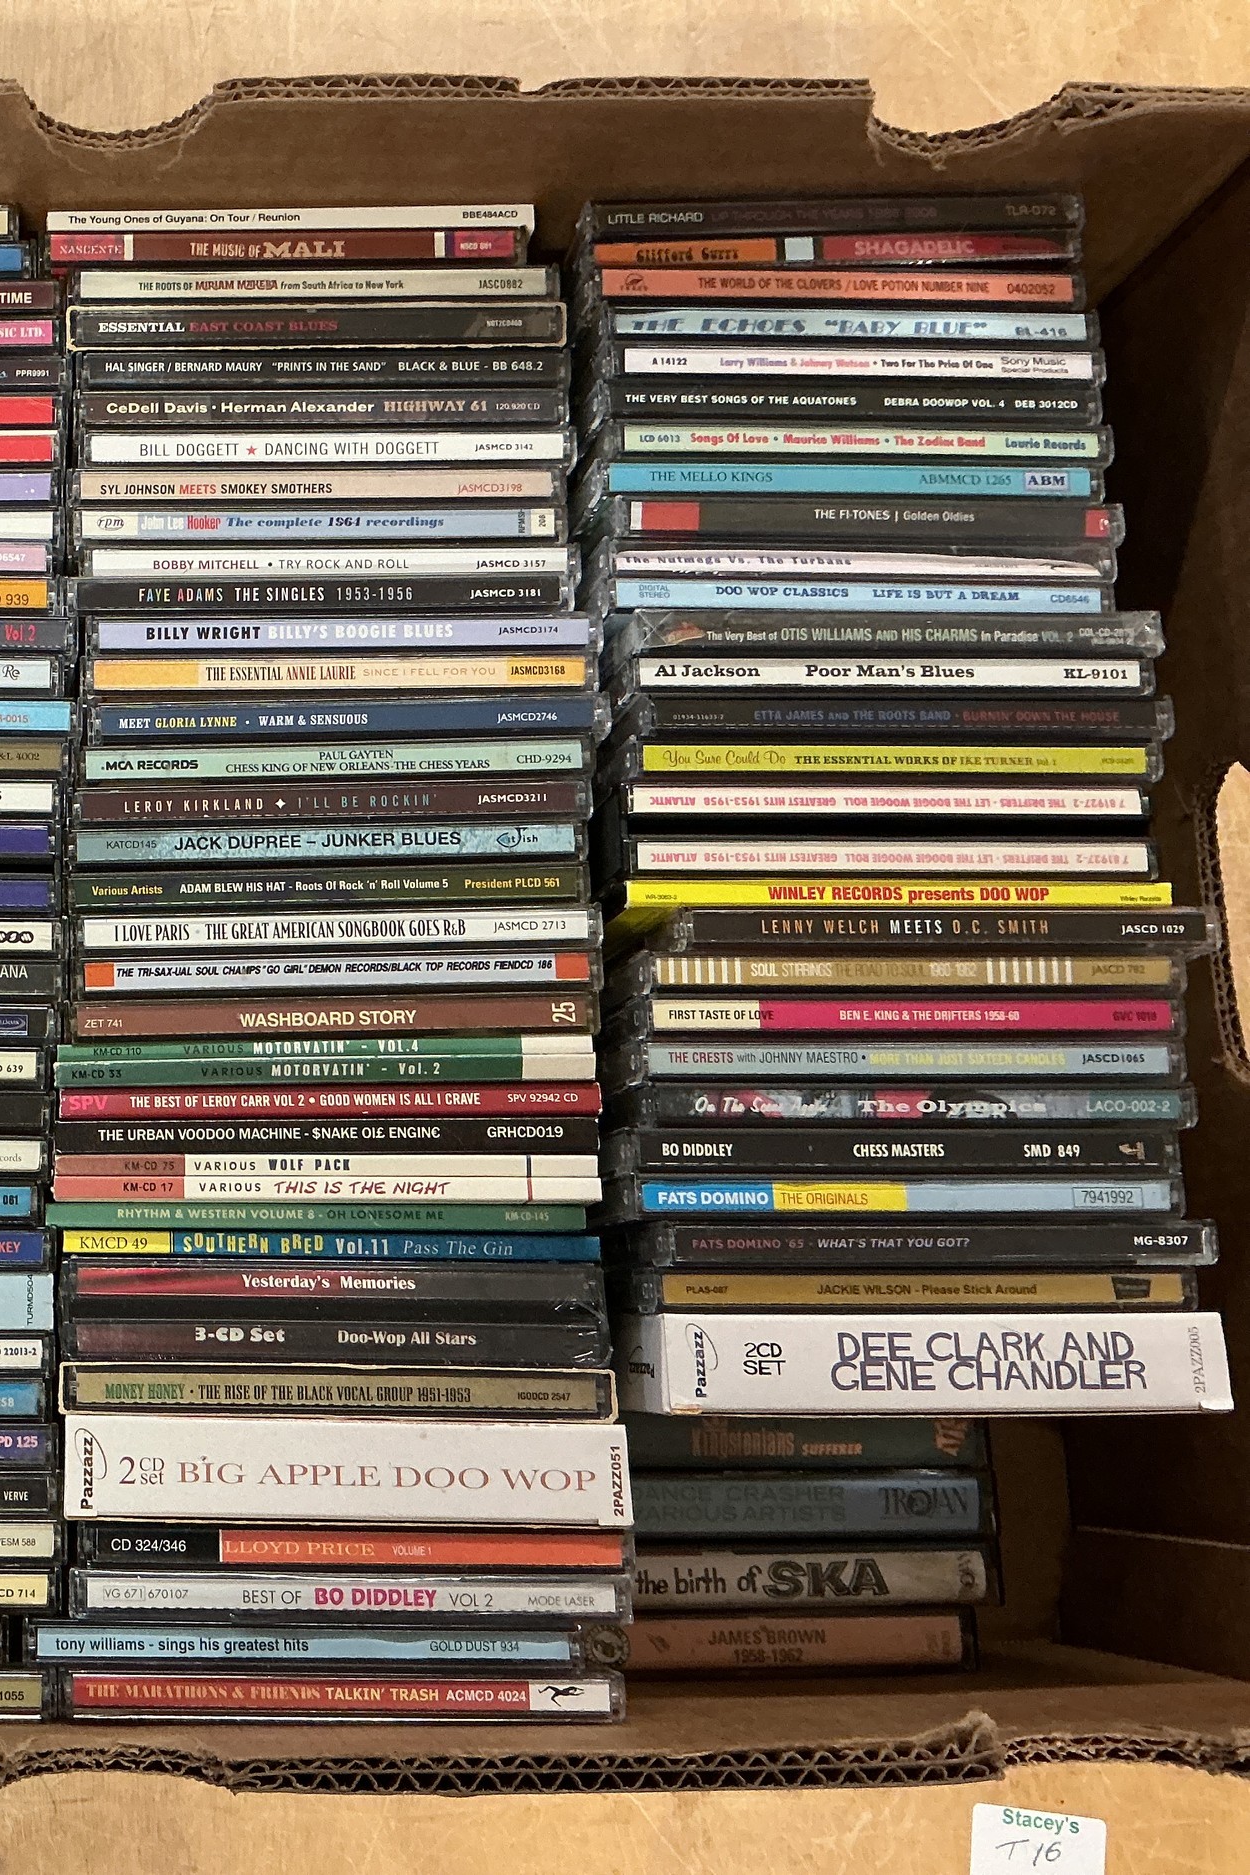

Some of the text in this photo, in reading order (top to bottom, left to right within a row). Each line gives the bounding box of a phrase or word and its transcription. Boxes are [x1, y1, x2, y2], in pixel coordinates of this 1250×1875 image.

[462, 210, 518, 218] BBE484ACD
[608, 212, 703, 224] LITTLE RICHARD
[855, 240, 975, 256] SHAGADELIC
[98, 322, 184, 332] ESSENTIAL
[1015, 400, 1078, 408] DEB 3012CD
[650, 471, 773, 483] THE MELLO KINGS
[1028, 475, 1065, 487] ABM
[146, 624, 453, 640] BILLY WRIGHT BILLY'S BOOGIE BLUES
[655, 665, 760, 676] Al Jackson
[805, 664, 974, 677] Poor Man's Blues
[1064, 668, 1127, 679] KL-9101
[516, 754, 571, 764] CHD-9294
[106, 840, 157, 850] KATCD145
[768, 886, 1049, 903] WINLEY RECORDS presents DOO WOP
[239, 1010, 416, 1027] WASHBOARD STORY
[551, 1002, 575, 1023] 25
[6, 1065, 23, 1073] 639
[662, 1143, 732, 1156] BO DIDDLEY
[658, 1191, 768, 1204] FATS DOMINO
[1082, 1190, 1134, 1204] 7941992
[79, 1235, 148, 1250] KMCD 49
[1134, 1236, 1188, 1245] MG-8307
[242, 1272, 415, 1290] Yesterday's Memories
[744, 1343, 782, 1358] 2CD
[838, 1332, 1134, 1361] DEE CLARK AND
[694, 1331, 705, 1398] Pazzazz
[744, 1360, 785, 1376] SET
[831, 1361, 1147, 1390] GENE CHANDLER
[119, 1456, 136, 1485] 2
[140, 1458, 164, 1471] CD
[80, 1438, 94, 1509] Pazzazz
[140, 1472, 164, 1485] set
[178, 1462, 595, 1491] BIG APPLE DOO WOP
[613, 1445, 623, 1516] 2PAZZ051
[4, 1491, 28, 1501] VERVE
[22, 1538, 36, 1546] 588
[636, 1559, 889, 1596] the birth of SKA
[242, 1588, 493, 1607] BEST OF BO DIDDLEY VOL 2
[430, 1640, 520, 1652] GOLD DUST 934
[1002, 1808, 1080, 1834] Stacey's
